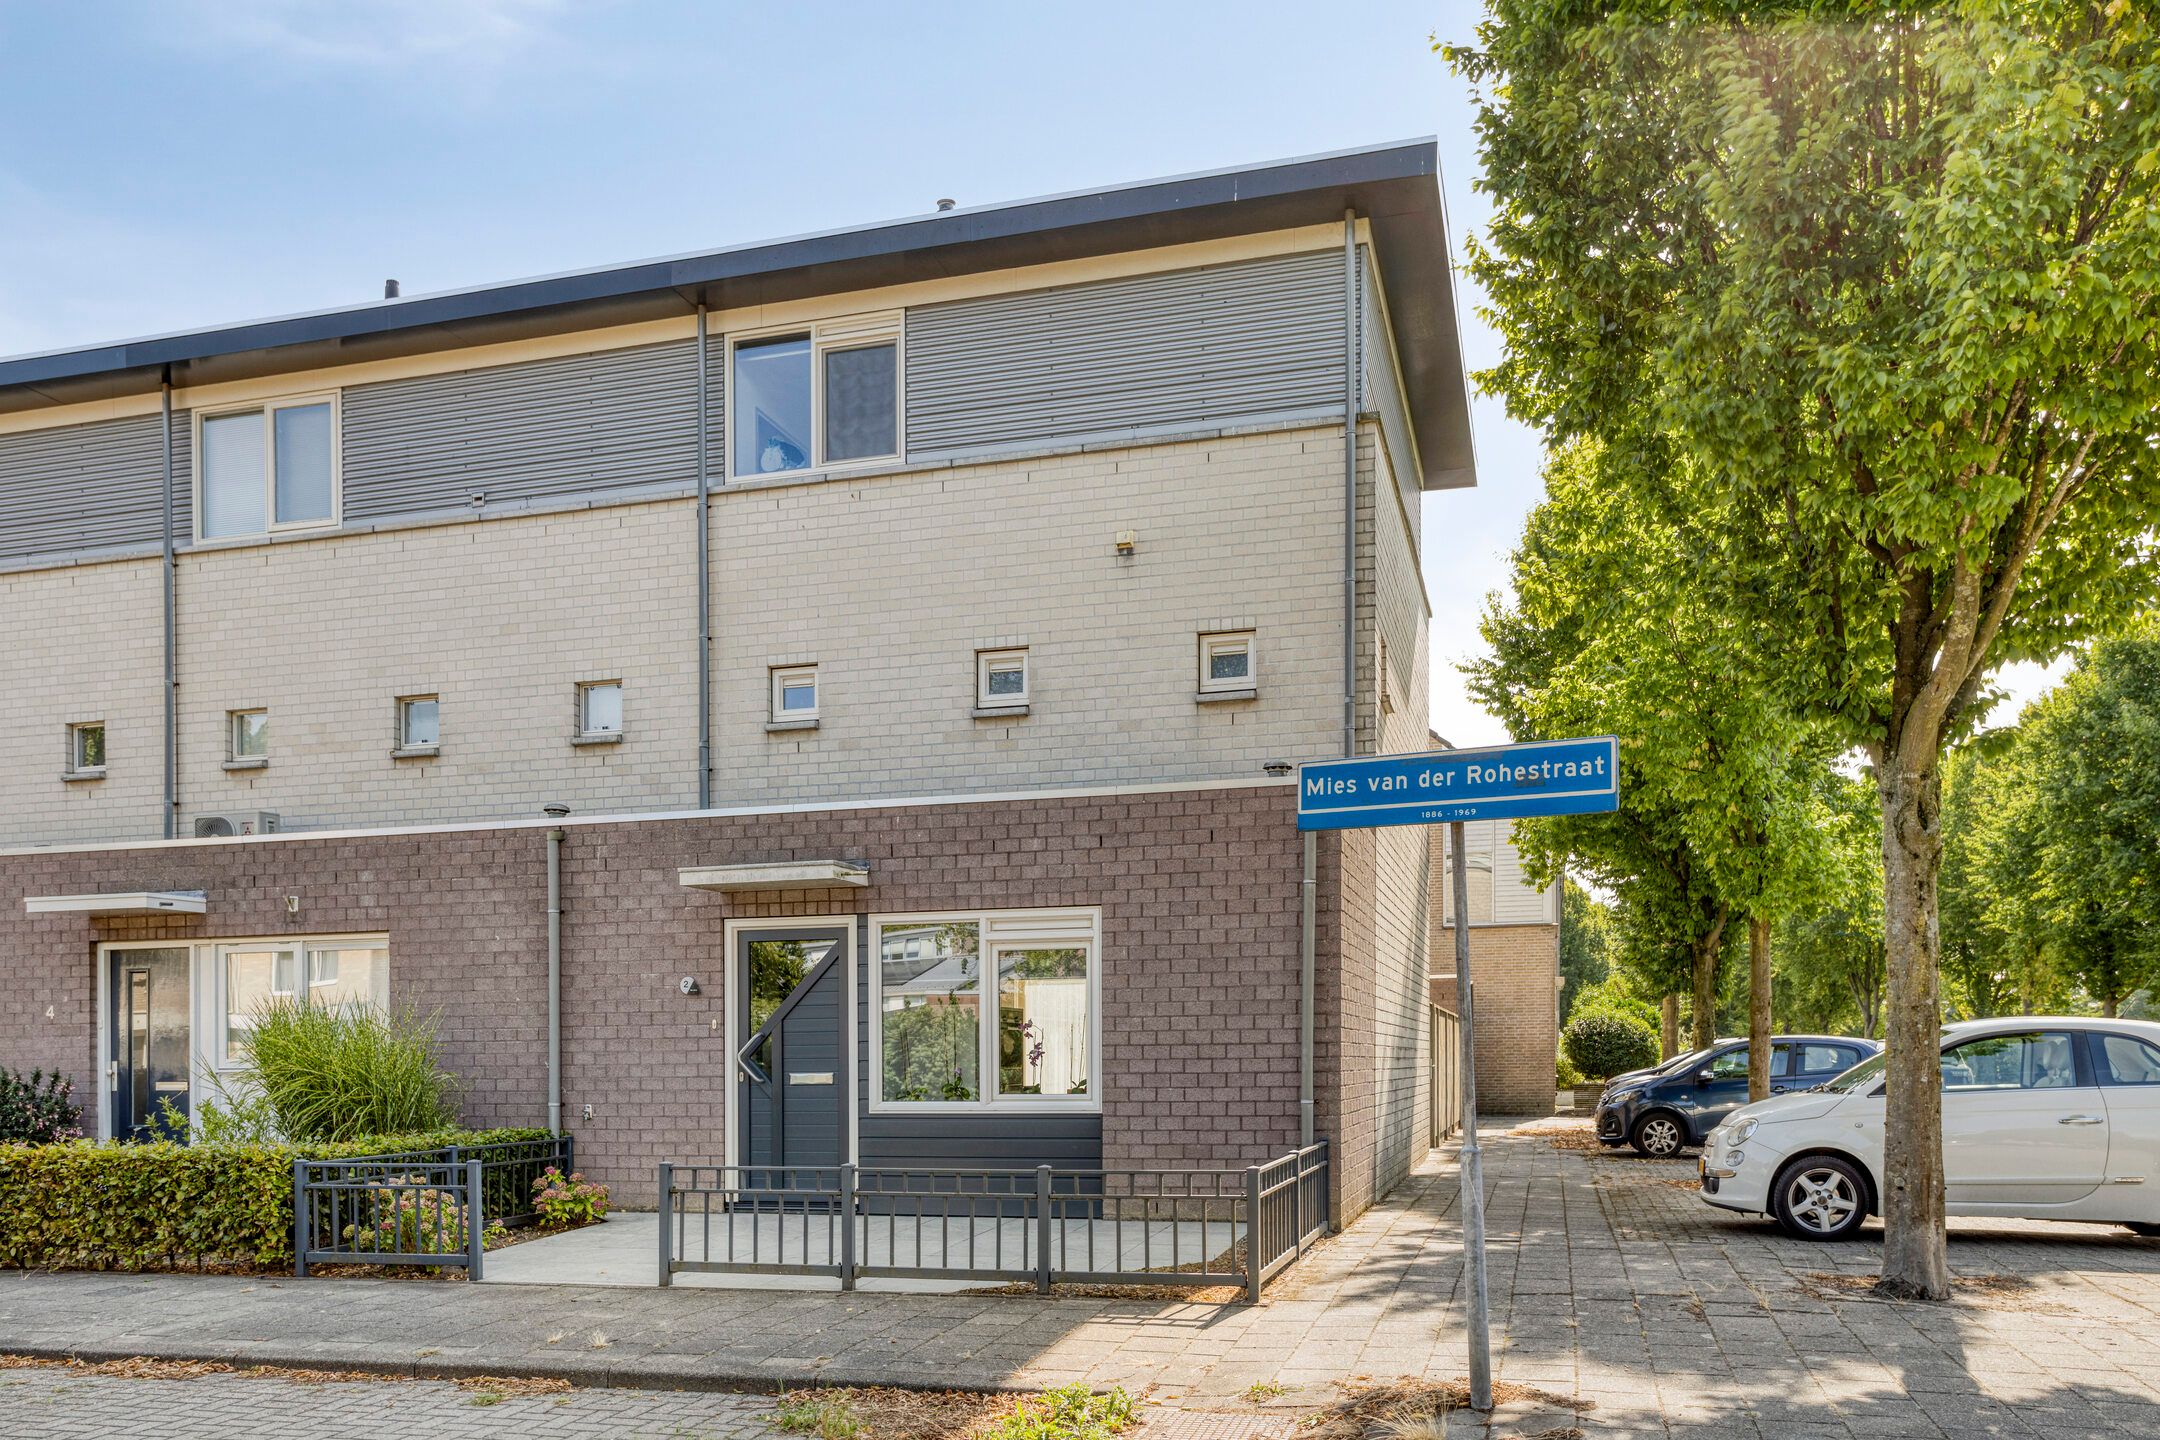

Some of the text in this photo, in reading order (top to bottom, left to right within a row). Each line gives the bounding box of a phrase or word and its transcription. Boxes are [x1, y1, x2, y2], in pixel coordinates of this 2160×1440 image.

[1307, 755, 1605, 796] Mies van der Rohestraat
[1454, 808, 1476, 816] 1969
[683, 980, 689, 988] 2
[45, 1004, 55, 1020] 4
